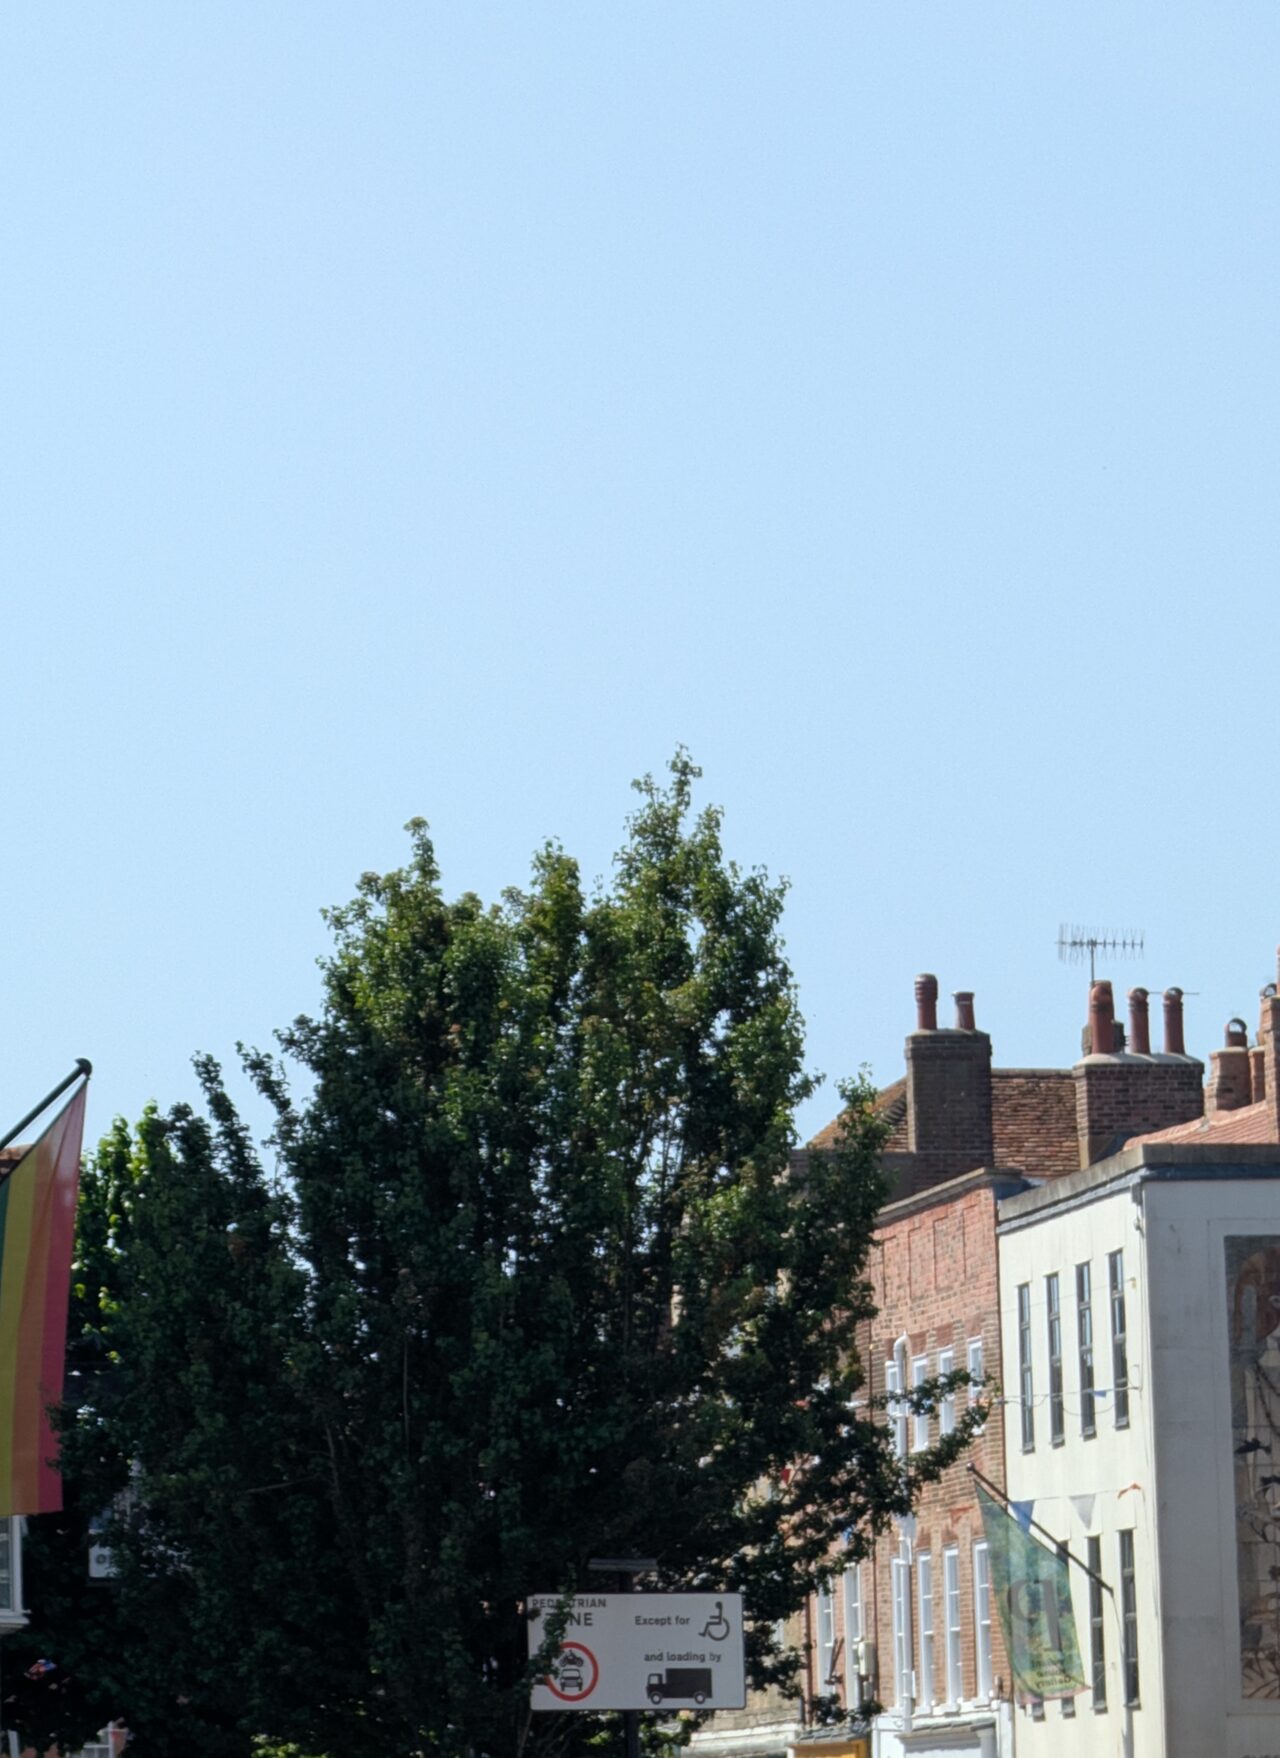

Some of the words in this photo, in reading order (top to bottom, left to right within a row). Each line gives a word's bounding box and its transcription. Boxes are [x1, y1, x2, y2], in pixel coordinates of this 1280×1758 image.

[532, 1598, 607, 1608] PEDTRIAN
[544, 1612, 593, 1627] NE
[634, 1615, 672, 1627] Except
[675, 1615, 690, 1625] for
[644, 1651, 663, 1662] and
[666, 1651, 705, 1663] loading
[709, 1651, 722, 1663] by
